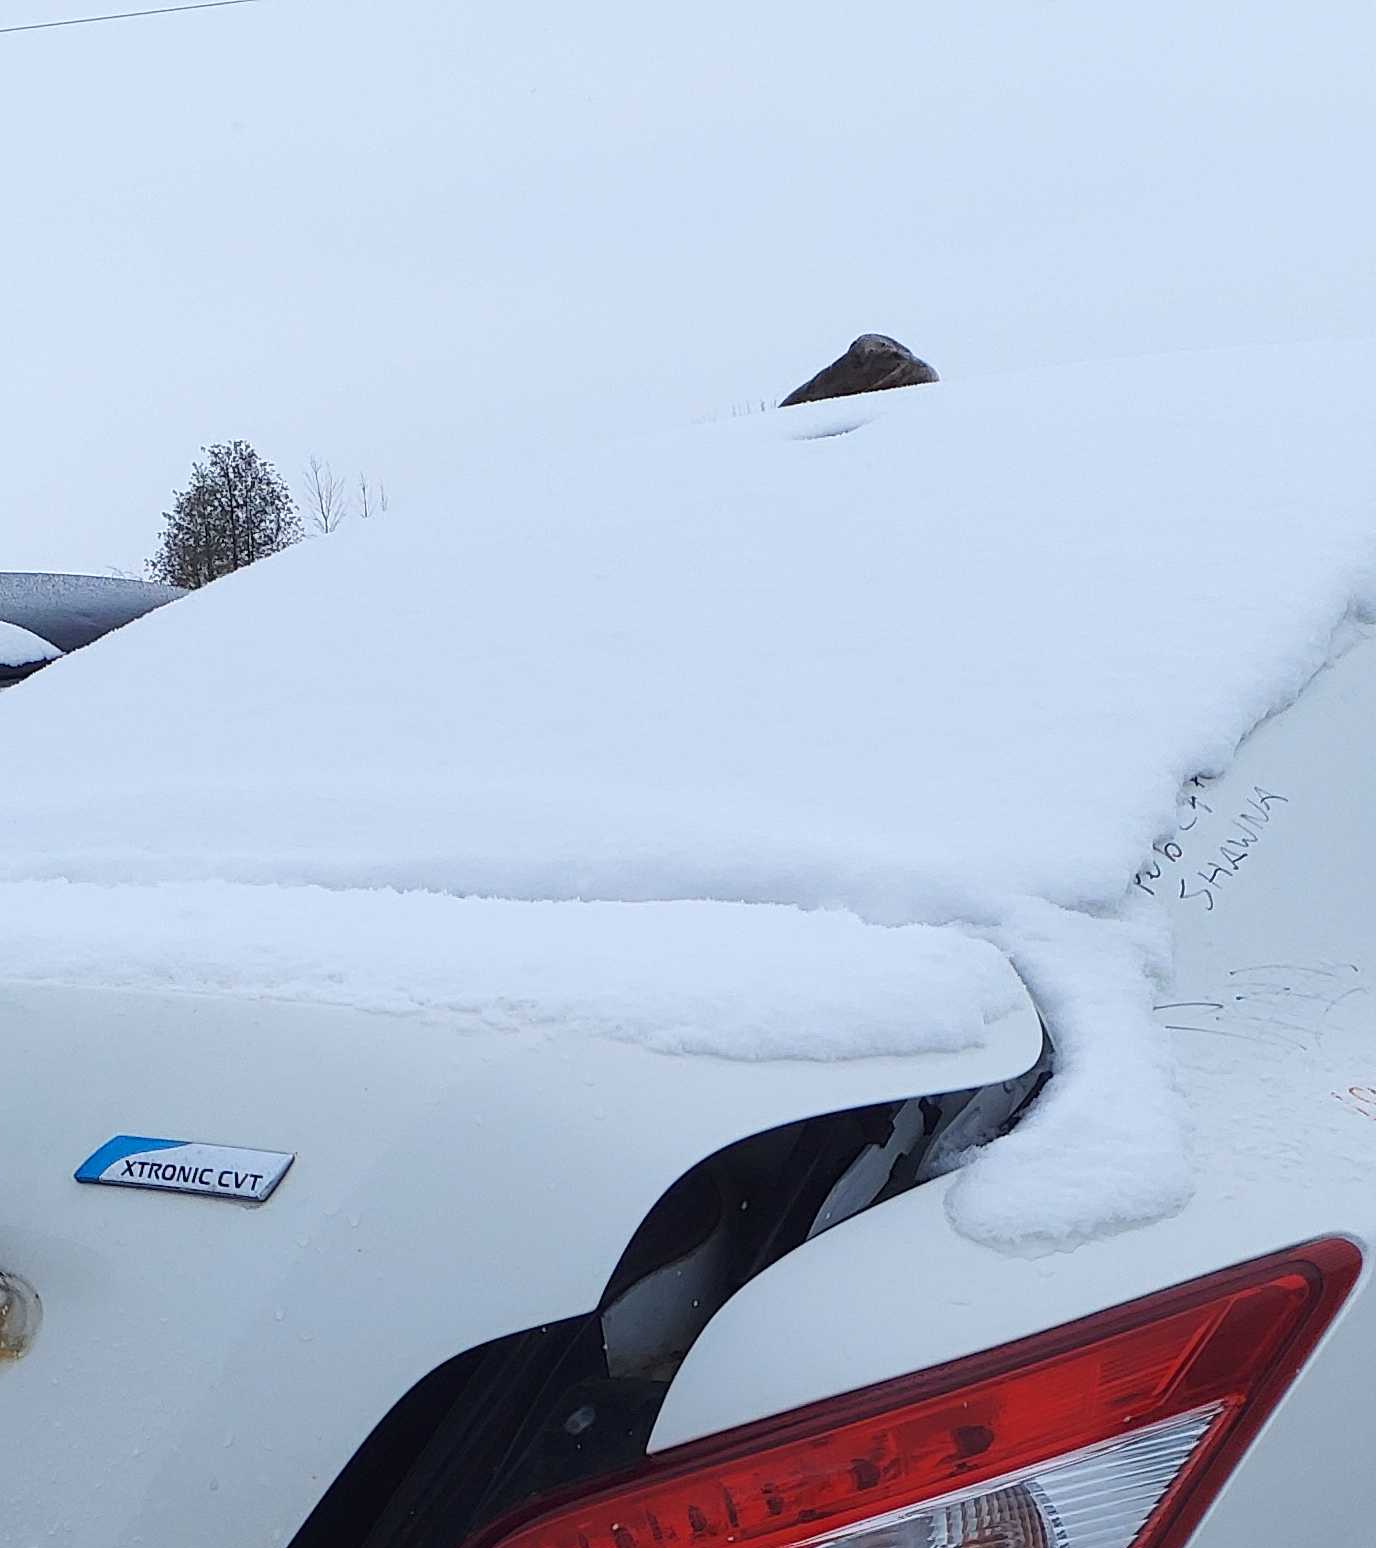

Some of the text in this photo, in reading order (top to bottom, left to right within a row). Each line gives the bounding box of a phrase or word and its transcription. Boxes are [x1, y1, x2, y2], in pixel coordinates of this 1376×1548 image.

[1179, 785, 1289, 911] SHAWNA
[120, 1159, 265, 1192] XTRONIC CVT
